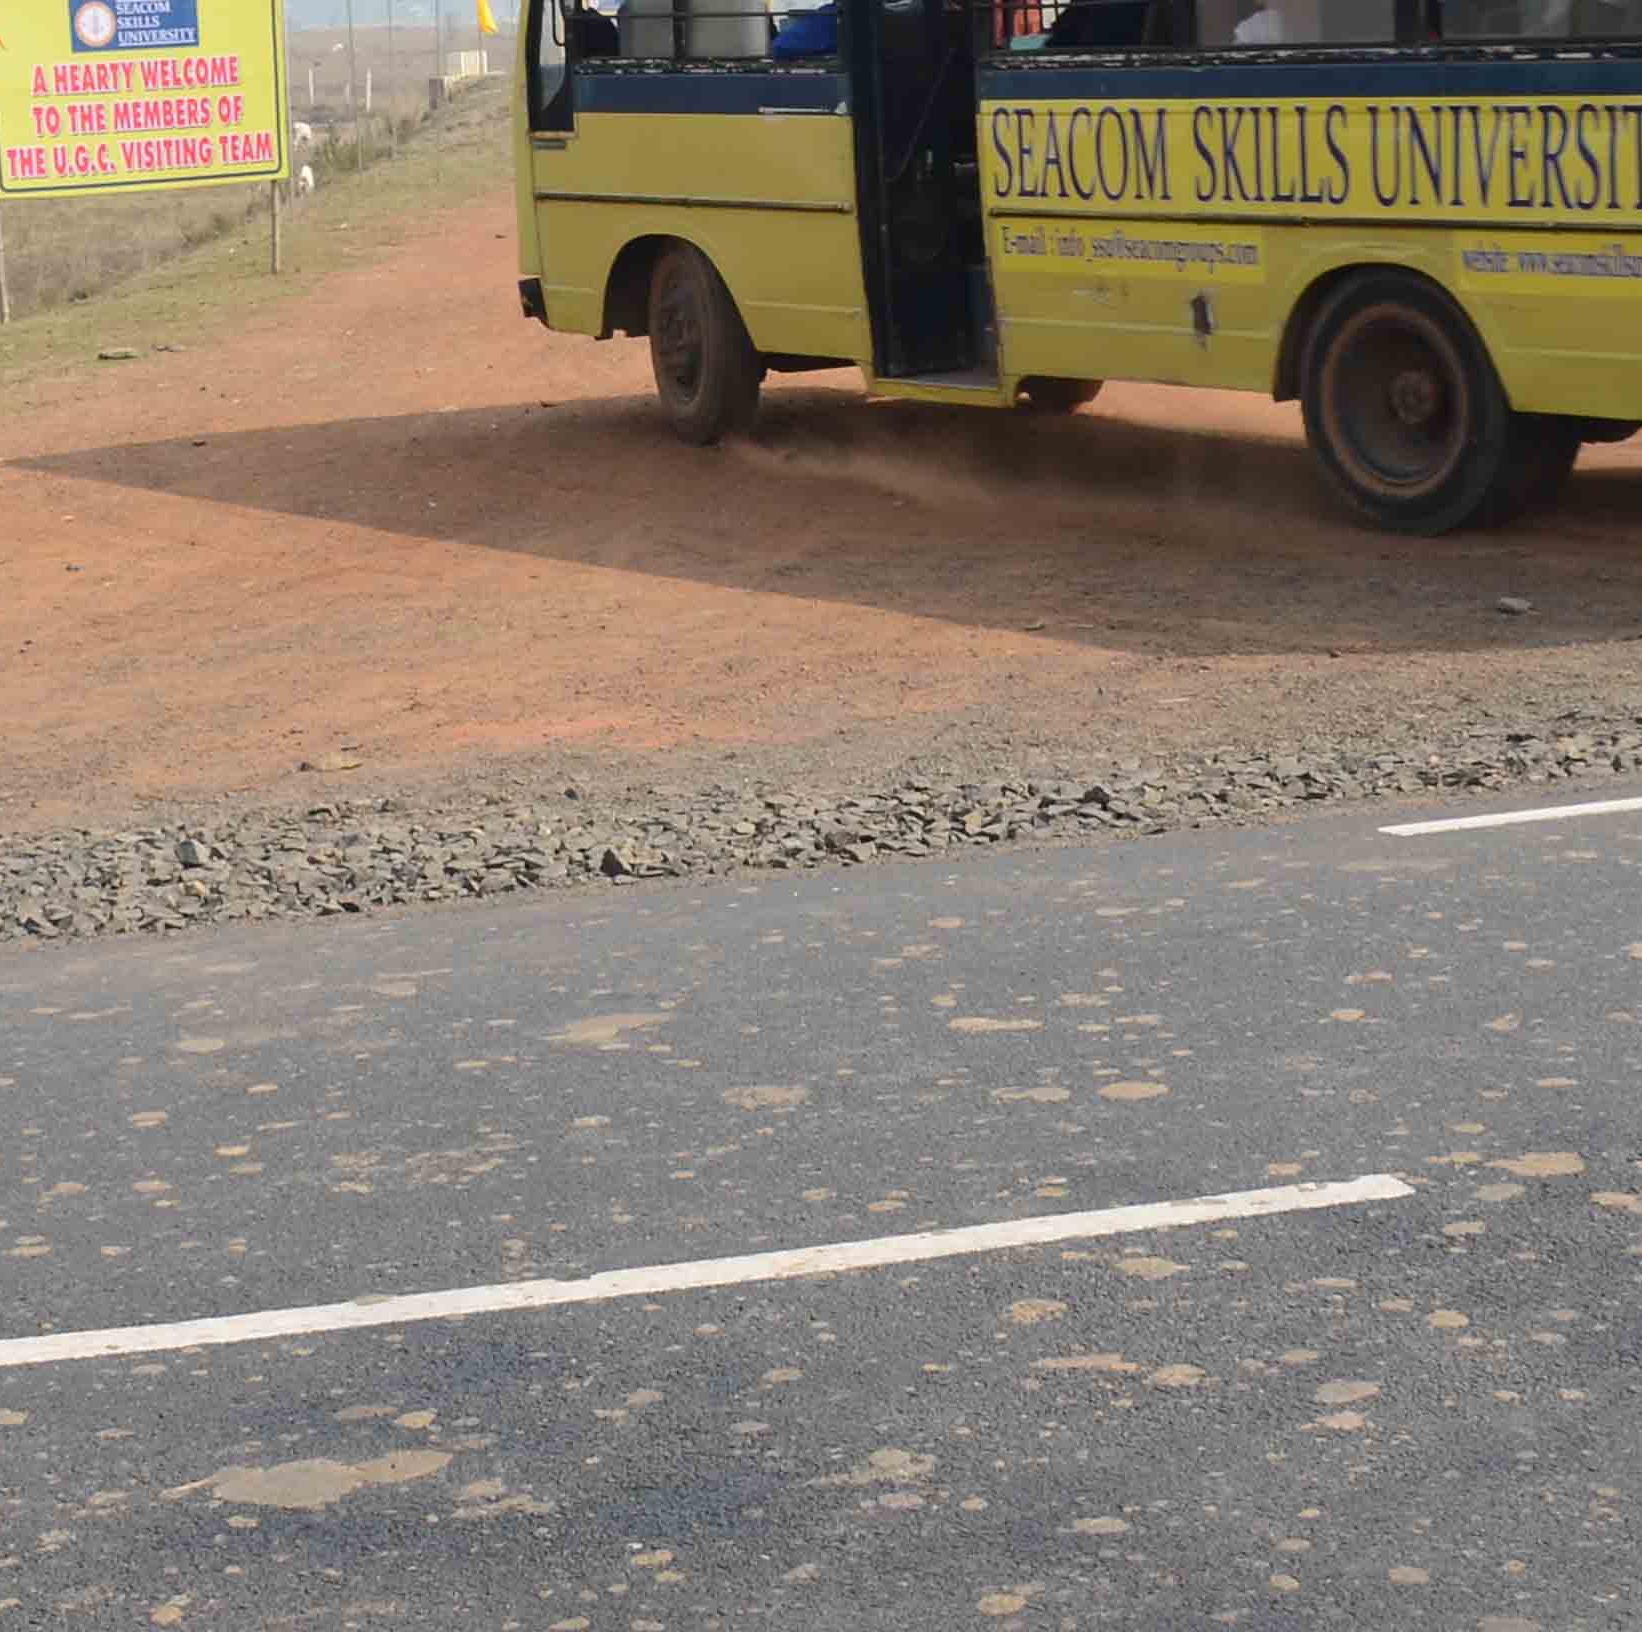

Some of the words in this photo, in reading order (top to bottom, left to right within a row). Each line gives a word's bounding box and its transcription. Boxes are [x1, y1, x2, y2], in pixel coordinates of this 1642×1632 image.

[116, 0, 172, 15] SEACOM
[117, 15, 161, 29] SKILLS
[118, 27, 196, 43] UNIVERSITY
[33, 65, 47, 96] A
[54, 62, 134, 94] HEARTY
[142, 55, 239, 89] WELCOME
[33, 105, 61, 135] TO
[67, 104, 106, 131] THE
[113, 98, 212, 131] MEMBERS
[218, 95, 242, 124] OF
[7, 146, 46, 176] THE
[53, 143, 116, 176] U.G.C.
[121, 136, 213, 170] VISITING
[219, 133, 273, 163] TEAM
[991, 106, 1172, 202] SEACOM
[1192, 104, 1350, 206] SKILLS
